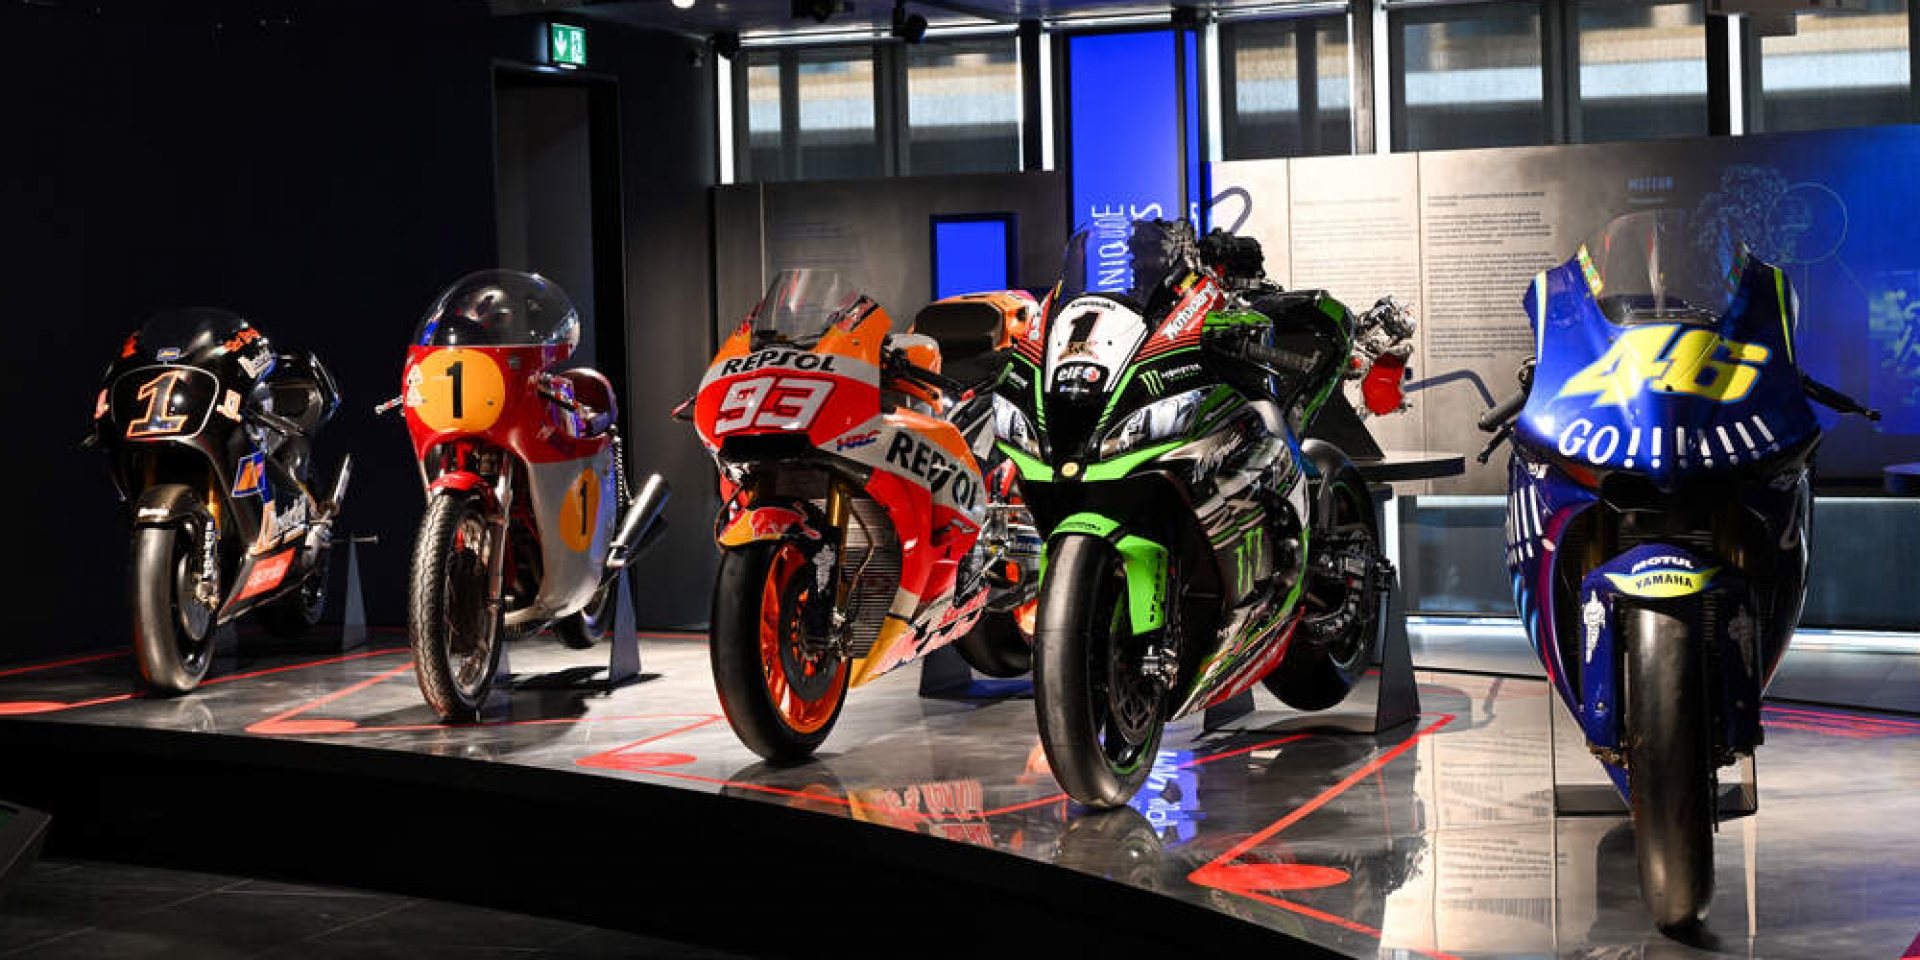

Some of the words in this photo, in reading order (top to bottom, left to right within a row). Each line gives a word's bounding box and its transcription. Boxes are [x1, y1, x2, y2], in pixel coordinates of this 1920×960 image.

[1060, 308, 1103, 359] 1
[446, 361, 463, 419] 1
[721, 350, 836, 376] REPSOL
[1557, 323, 1773, 408] 46
[126, 369, 189, 438] 1
[714, 375, 836, 438] 93
[579, 480, 588, 535] 1
[1631, 555, 1694, 574] MOTUL
[1636, 573, 1693, 589] YAMAHA
